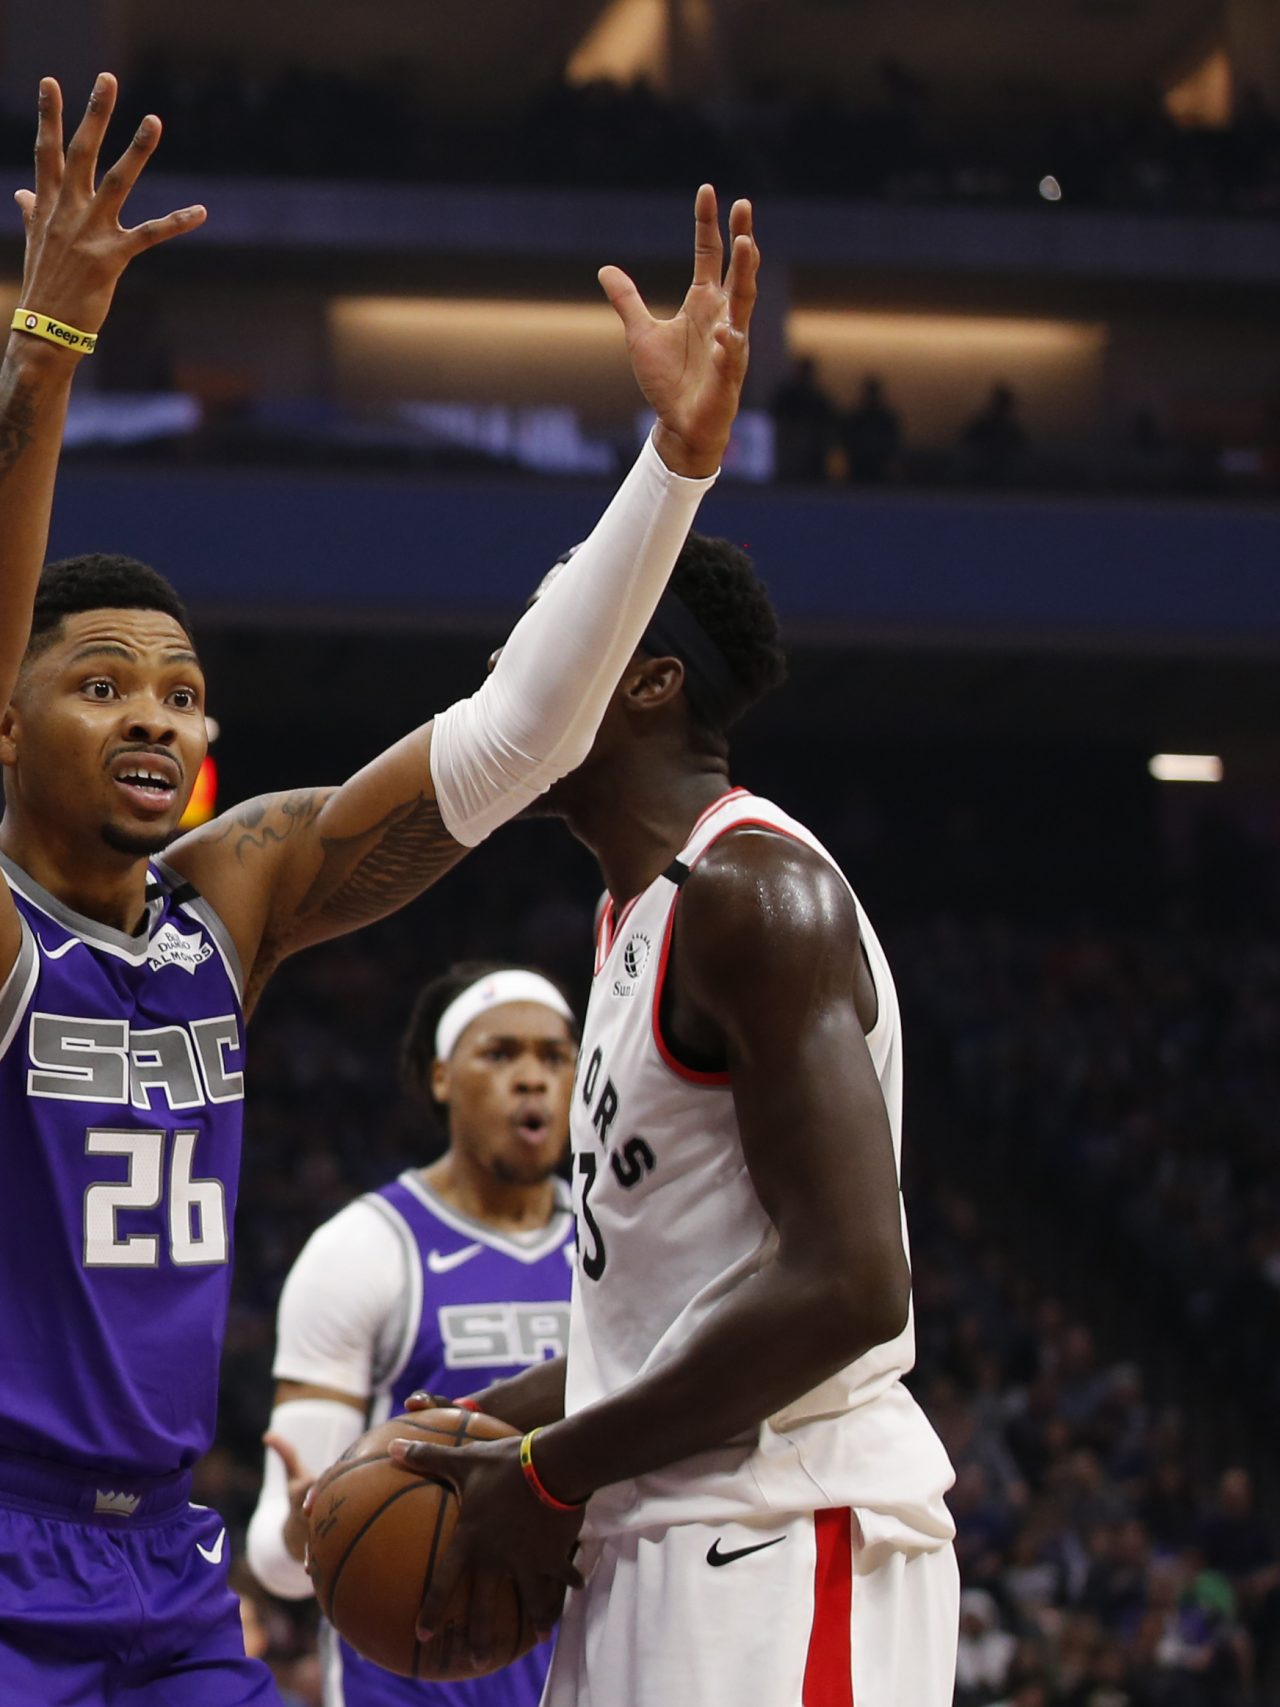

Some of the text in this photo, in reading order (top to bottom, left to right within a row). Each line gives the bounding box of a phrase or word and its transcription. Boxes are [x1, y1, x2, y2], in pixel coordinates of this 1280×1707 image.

[47, 322, 79, 345] Keep
[26, 1012, 245, 1110] SAC
[577, 1047, 656, 1189] ORS
[83, 1128, 228, 1268] 26
[571, 1152, 606, 1281] 3
